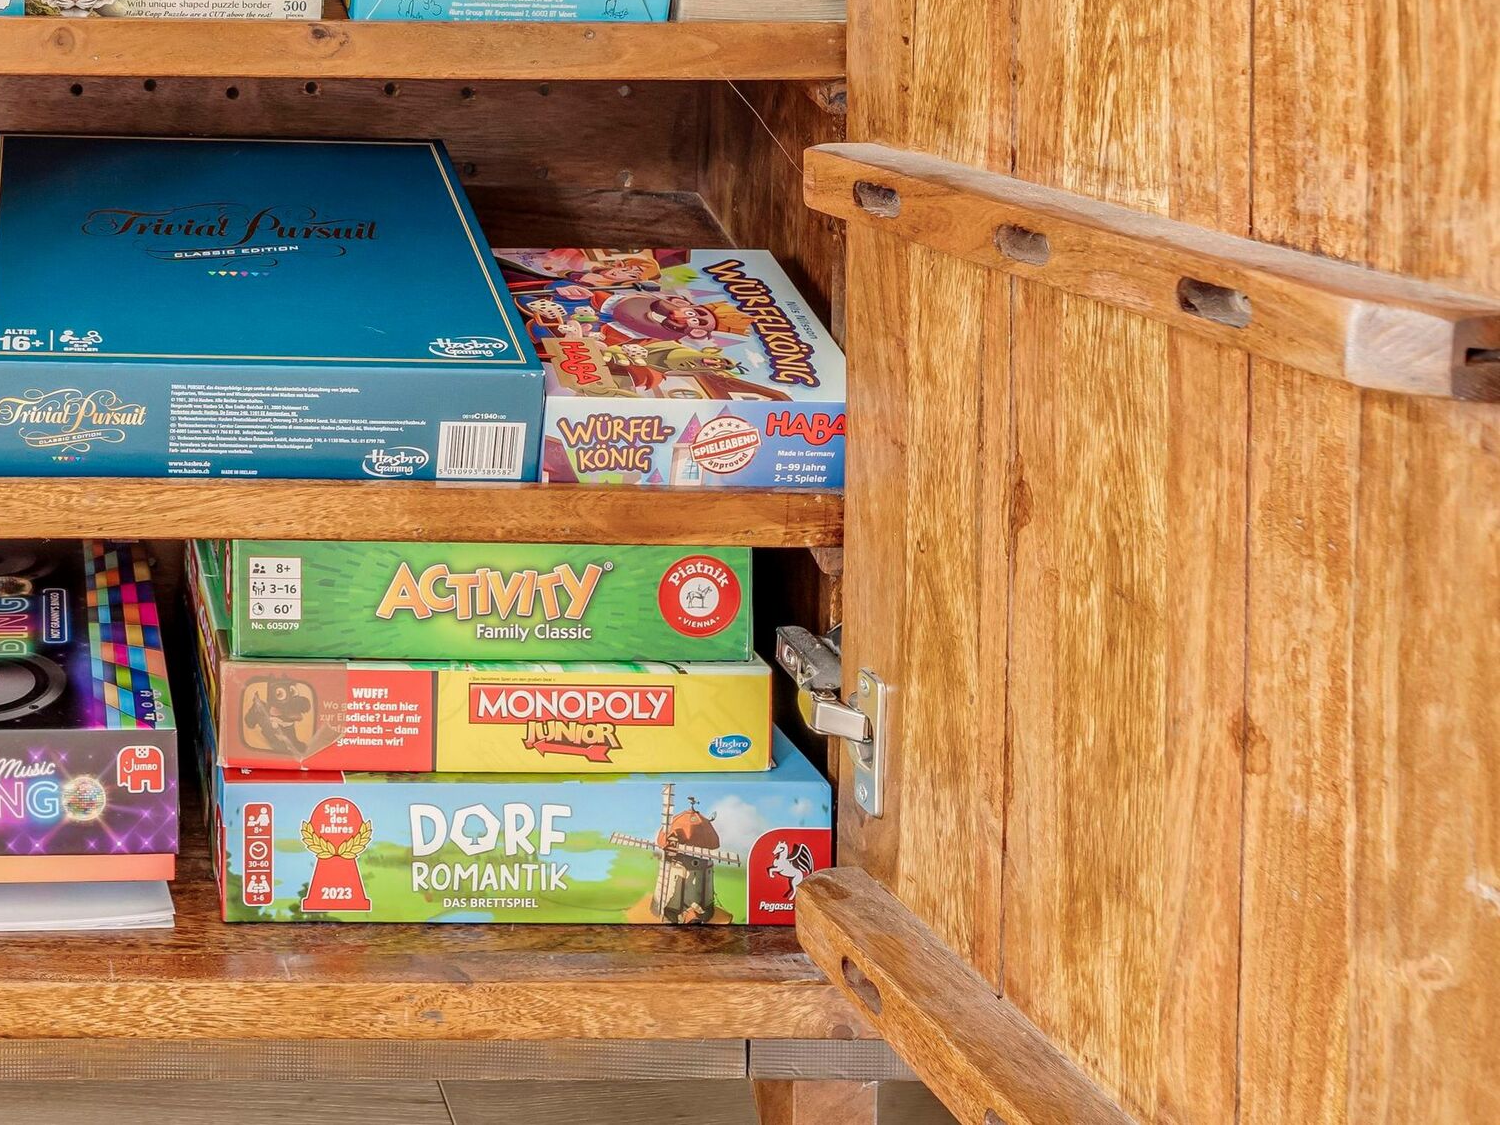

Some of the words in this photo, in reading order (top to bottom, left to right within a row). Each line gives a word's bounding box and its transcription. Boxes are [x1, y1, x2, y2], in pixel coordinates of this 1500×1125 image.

[127, 0, 147, 8] With
[148, 1, 177, 10] unique
[179, 0, 210, 10] shaped
[211, 0, 240, 10] puzzle
[241, 1, 271, 9] border
[283, 0, 307, 12] 300
[82, 208, 230, 237] Trivial
[231, 205, 379, 246] Pursuit
[174, 248, 236, 258] CLASSIC
[241, 245, 299, 254] EDITION
[705, 259, 818, 386] WÜRFELKÖNIG
[430, 338, 504, 350] Hasbro
[559, 341, 602, 387] HABA
[69, 390, 146, 433] Pursuit
[559, 416, 673, 445] WÜRFEL-
[766, 412, 846, 445] HABA
[38, 435, 71, 445] CLASSIC
[72, 431, 103, 440] EDITION
[694, 433, 758, 457] SPIELEABEND
[364, 449, 426, 465] Hasbro
[578, 446, 651, 472] KÖNIG
[805, 450, 836, 458] Germany
[707, 451, 749, 471] approved
[802, 463, 827, 471] Jahre
[374, 463, 414, 475] Gaming
[795, 474, 827, 484] Spieler
[276, 563, 291, 573] 8+
[667, 562, 731, 588] Piatnik
[375, 561, 603, 620] ACTIVITY
[51, 592, 60, 607] BINGO
[251, 622, 266, 630] No.
[266, 622, 299, 630] 605079
[683, 617, 717, 627] VIENNA
[51, 628, 60, 639] NOT
[476, 623, 530, 642] Family
[534, 624, 592, 639] Classic
[352, 688, 389, 699] WUFF!
[341, 701, 371, 712] geht's
[372, 702, 397, 710] denn
[399, 702, 419, 711] hier
[477, 689, 668, 720] MONOPOLY
[337, 713, 380, 723] Eisdiele?
[382, 713, 404, 723] Lauf
[406, 713, 422, 723] mir
[360, 726, 383, 734] nach
[394, 726, 419, 734] dann
[525, 720, 621, 748] JUNIOR
[337, 737, 383, 747] gewinnen
[385, 737, 404, 746] wir!
[712, 737, 749, 749] Hasbro
[324, 804, 349, 815] Spiel
[330, 814, 348, 824] des
[253, 826, 263, 834] 8+
[320, 824, 353, 834] Jahres
[409, 802, 572, 856] DORF
[411, 861, 570, 892] ROMANTIK
[321, 887, 353, 900] 2023
[443, 897, 467, 908] DAS
[470, 897, 539, 908] BRETTSPIEL
[759, 901, 794, 912] Pegasus
